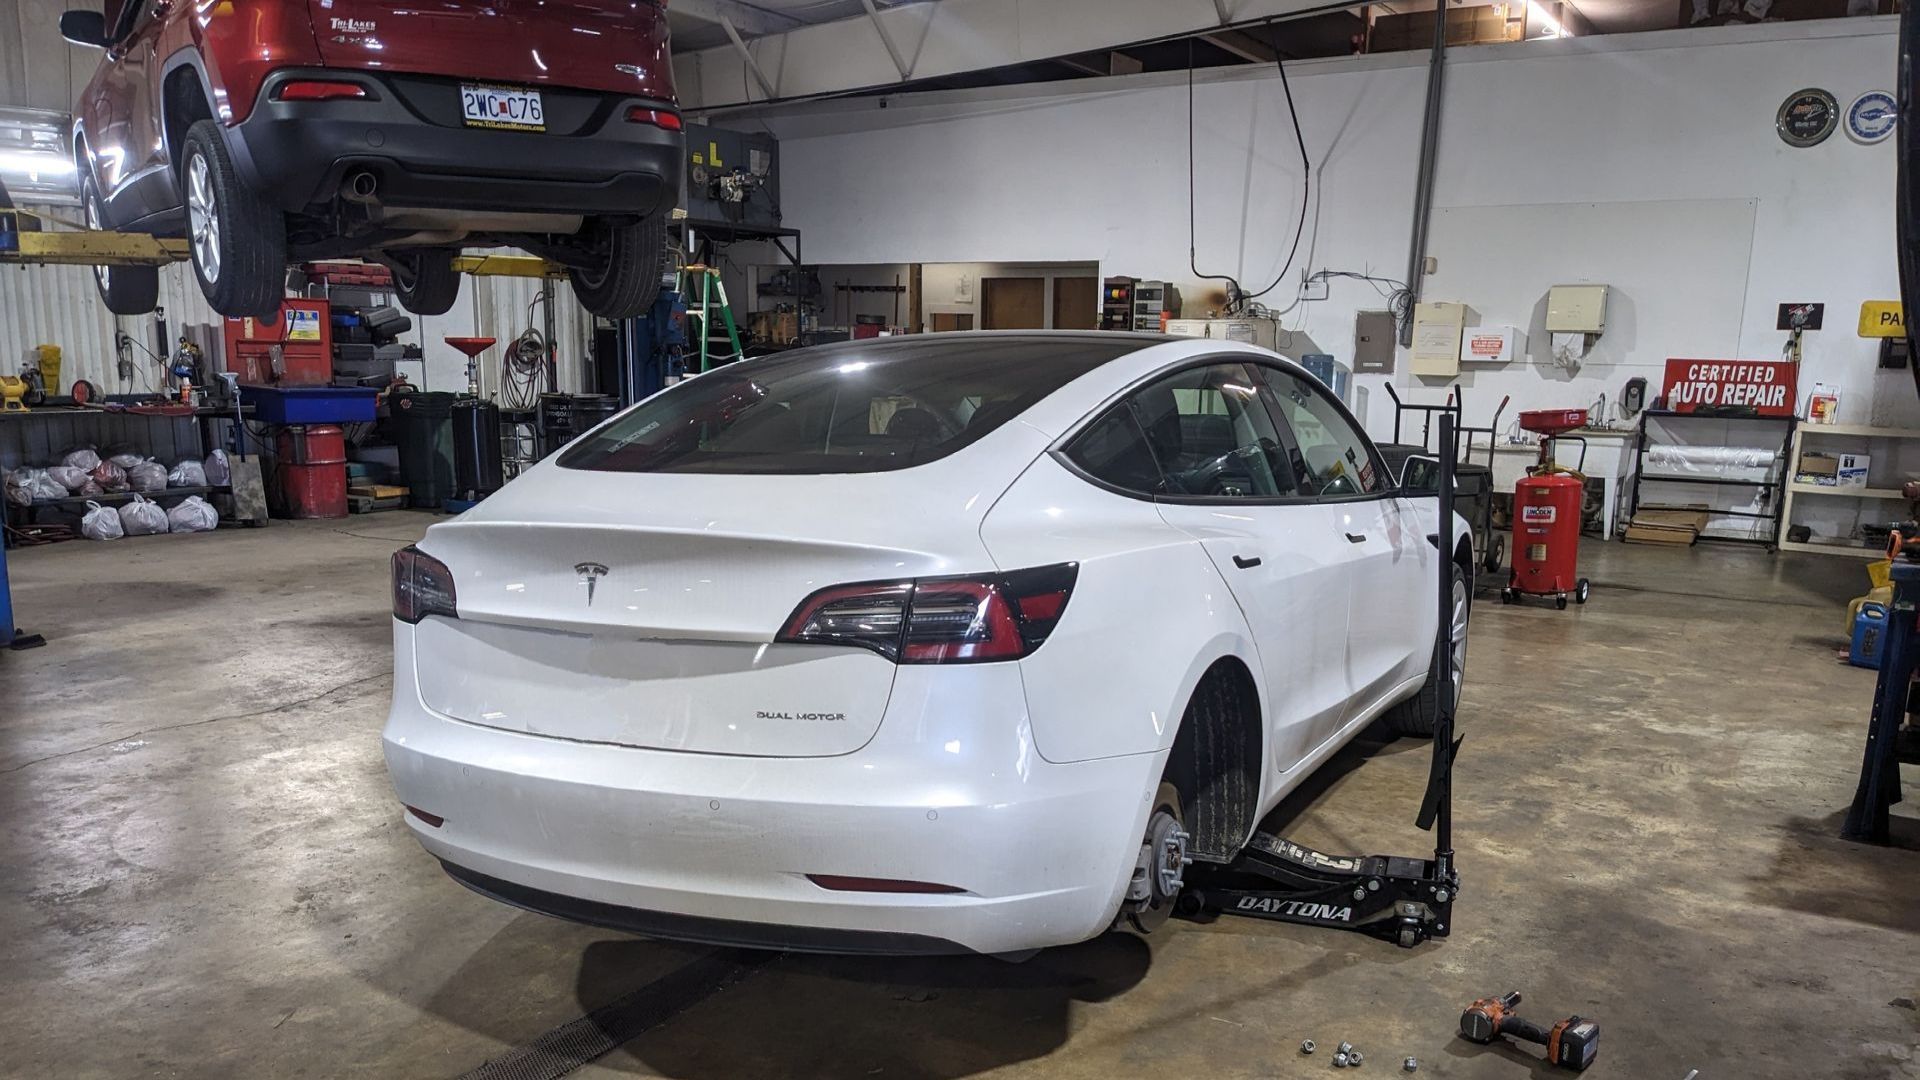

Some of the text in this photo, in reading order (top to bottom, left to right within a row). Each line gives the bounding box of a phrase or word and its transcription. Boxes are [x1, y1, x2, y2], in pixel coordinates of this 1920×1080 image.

[464, 93, 541, 120] 2WC C76
[1880, 311, 1905, 326] PA
[1688, 363, 1775, 383] CERTIFIED
[1672, 381, 1718, 404] AUTO
[1721, 383, 1786, 407] REPAIR
[756, 711, 847, 721] DUAL MOTOR
[1237, 895, 1352, 922] DAYTONA
